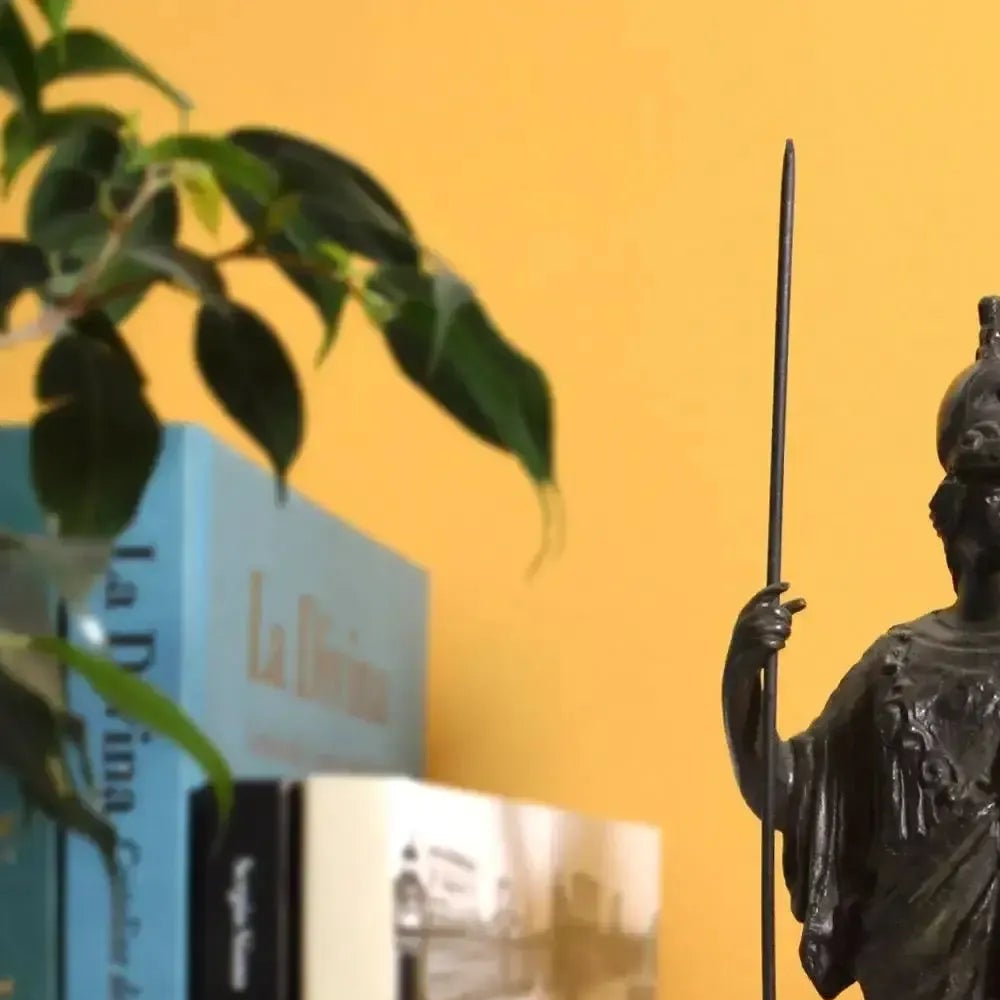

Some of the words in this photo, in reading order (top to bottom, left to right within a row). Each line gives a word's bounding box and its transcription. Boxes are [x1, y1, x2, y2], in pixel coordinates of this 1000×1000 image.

[106, 543, 159, 610] La
[247, 570, 287, 689] La
[105, 630, 158, 814] Dina
